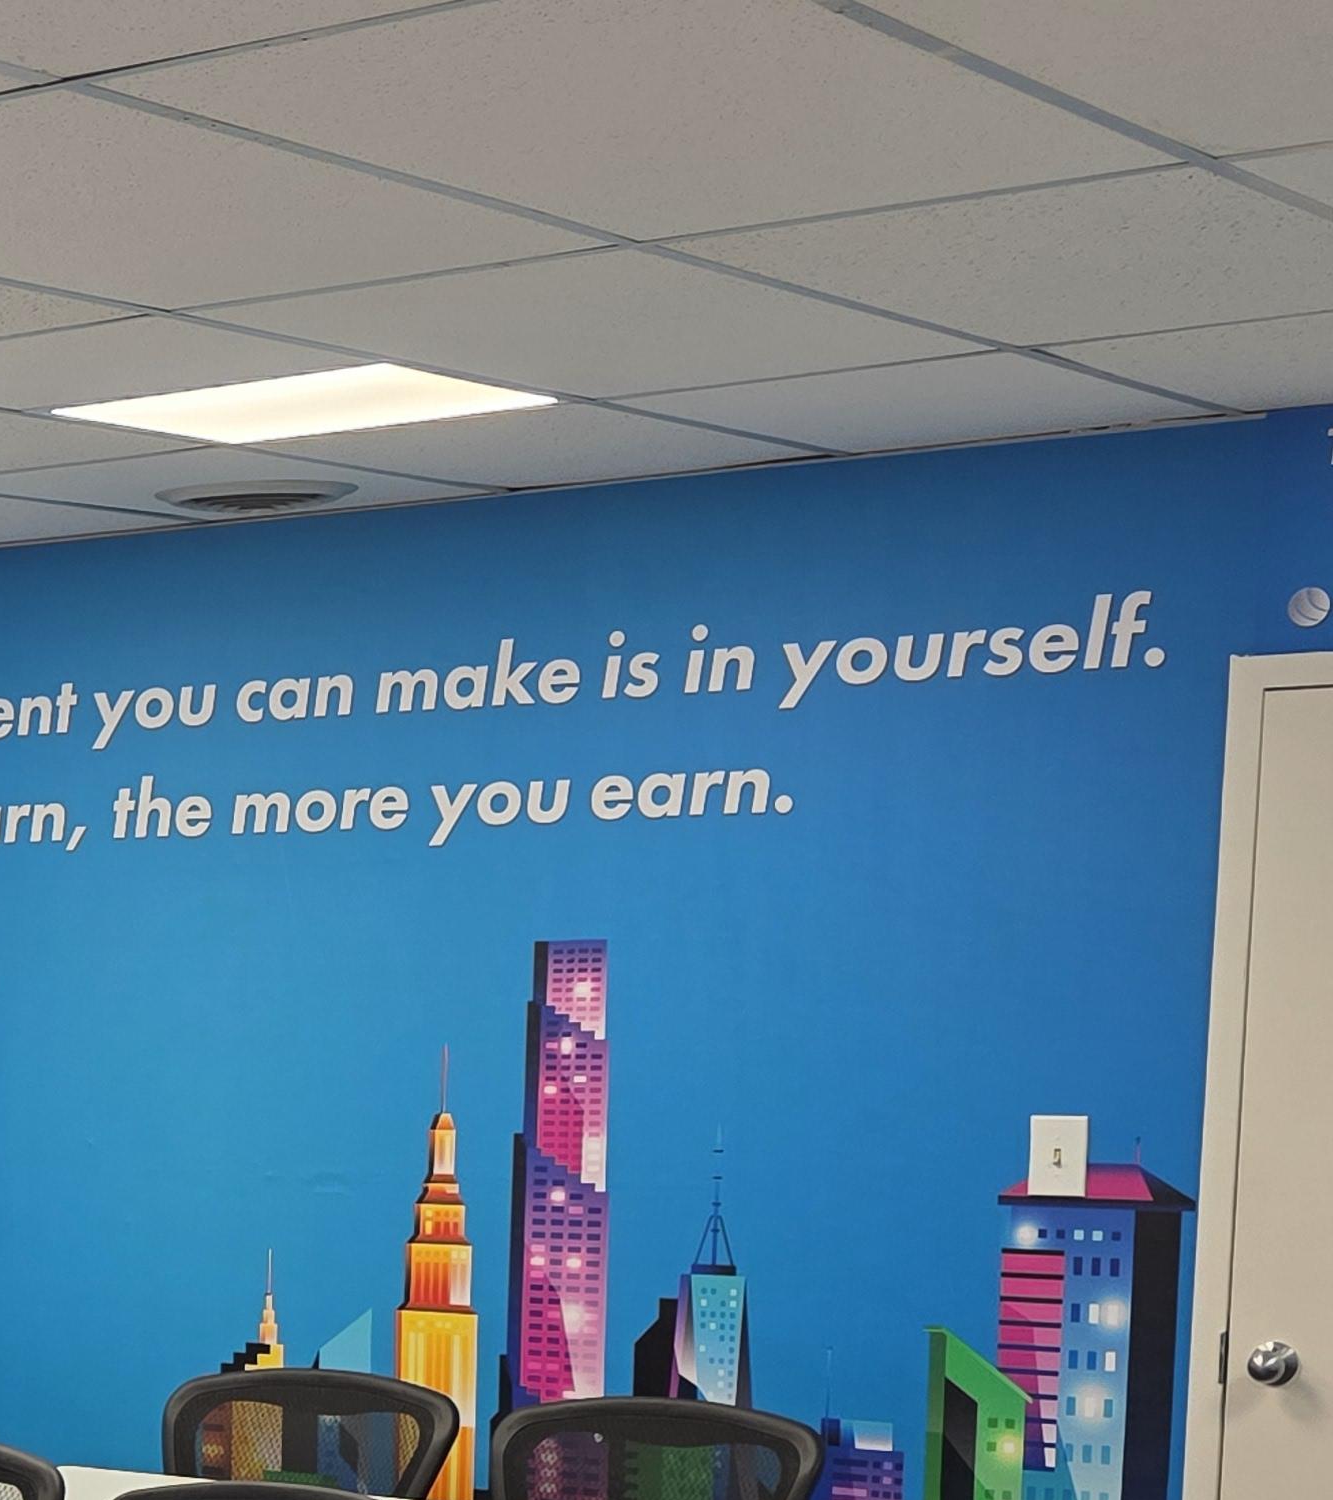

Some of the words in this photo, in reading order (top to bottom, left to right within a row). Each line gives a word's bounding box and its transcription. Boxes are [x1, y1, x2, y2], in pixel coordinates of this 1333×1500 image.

[93, 684, 217, 750] you
[235, 675, 354, 723] can
[375, 639, 581, 714] make
[601, 631, 660, 699] is
[684, 624, 755, 694] in
[779, 591, 1165, 710] yourself.
[113, 776, 212, 838] the
[231, 787, 409, 835] more
[428, 780, 571, 847] you
[590, 769, 794, 821] earn.
